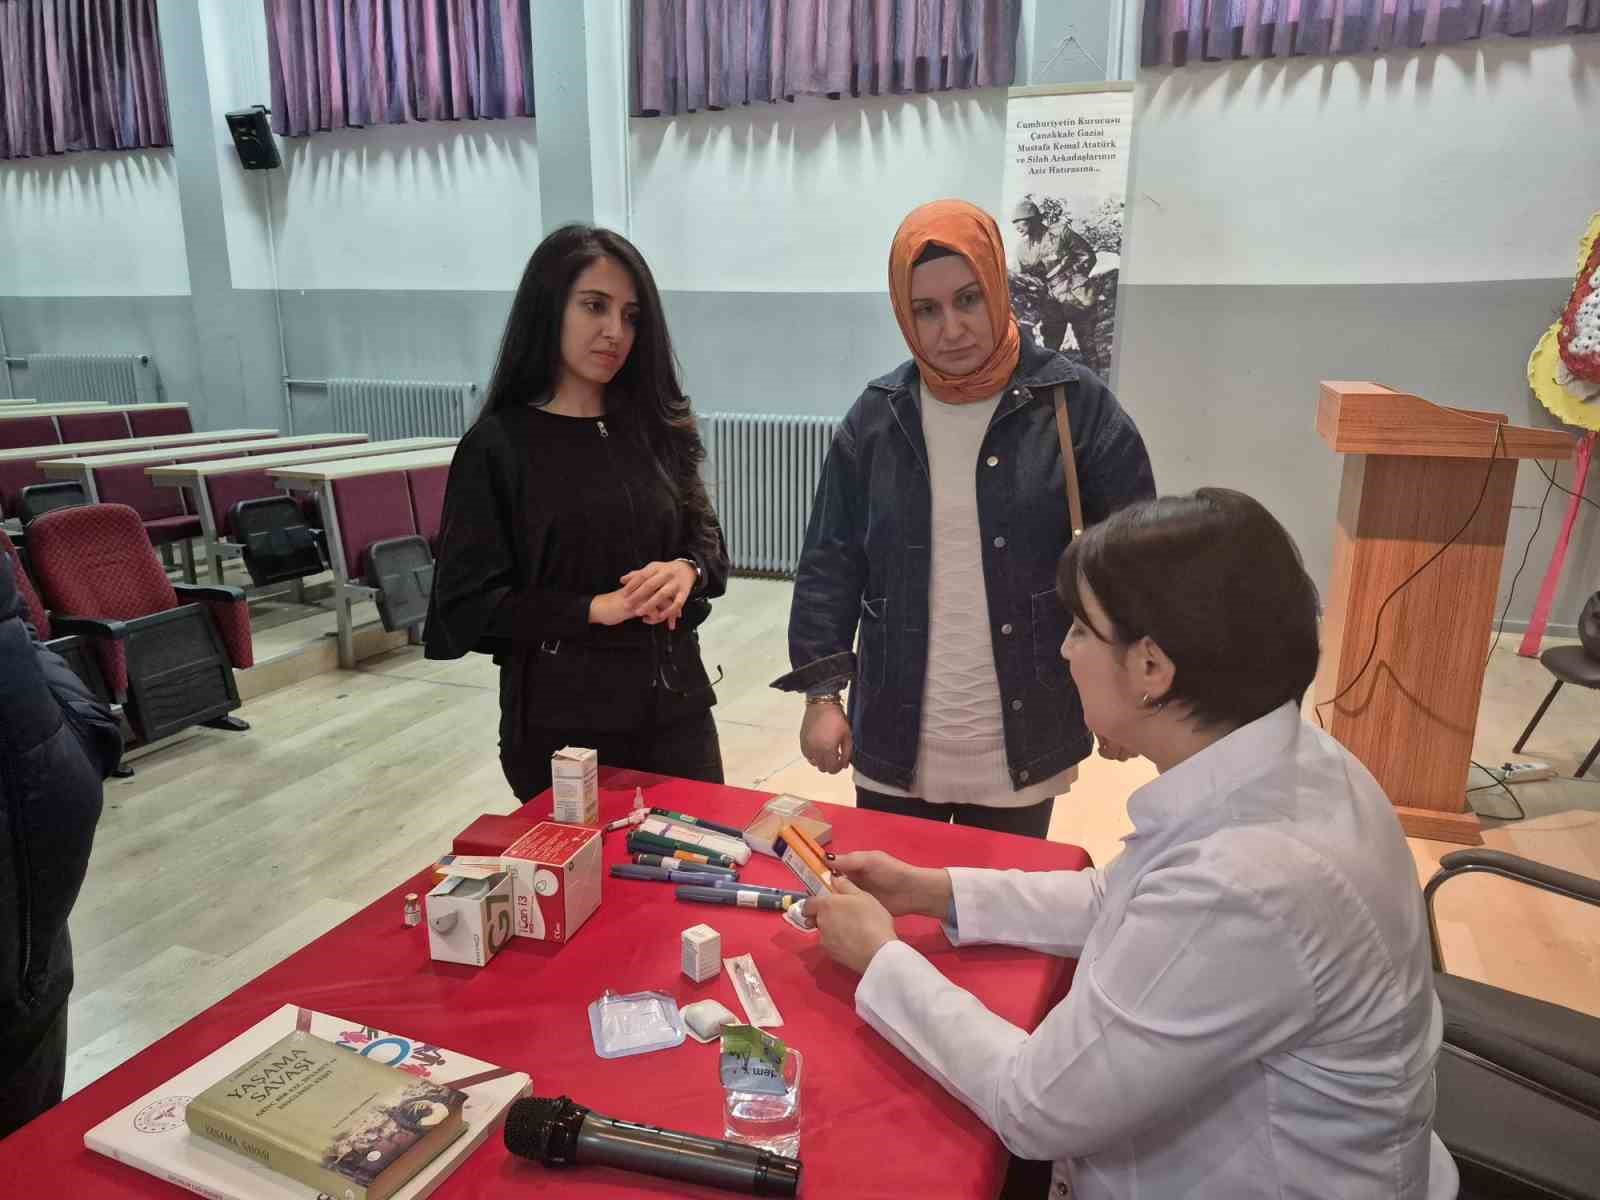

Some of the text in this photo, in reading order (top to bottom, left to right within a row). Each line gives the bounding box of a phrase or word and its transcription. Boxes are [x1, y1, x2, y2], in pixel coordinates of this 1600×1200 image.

[1016, 116, 1121, 130] Cumhuriyetin Kurucusu
[1030, 128, 1104, 141] Çanakkale Gazisi
[1016, 139, 1117, 153] Mustafa Kemal Atatürk
[1026, 154, 1049, 164] Silah
[1050, 153, 1117, 163] Arkadaşlarının
[1028, 166, 1046, 175] Aziz
[227, 1048, 308, 1099] YAŞAMA
[250, 1057, 316, 1103] SAVAŞI
